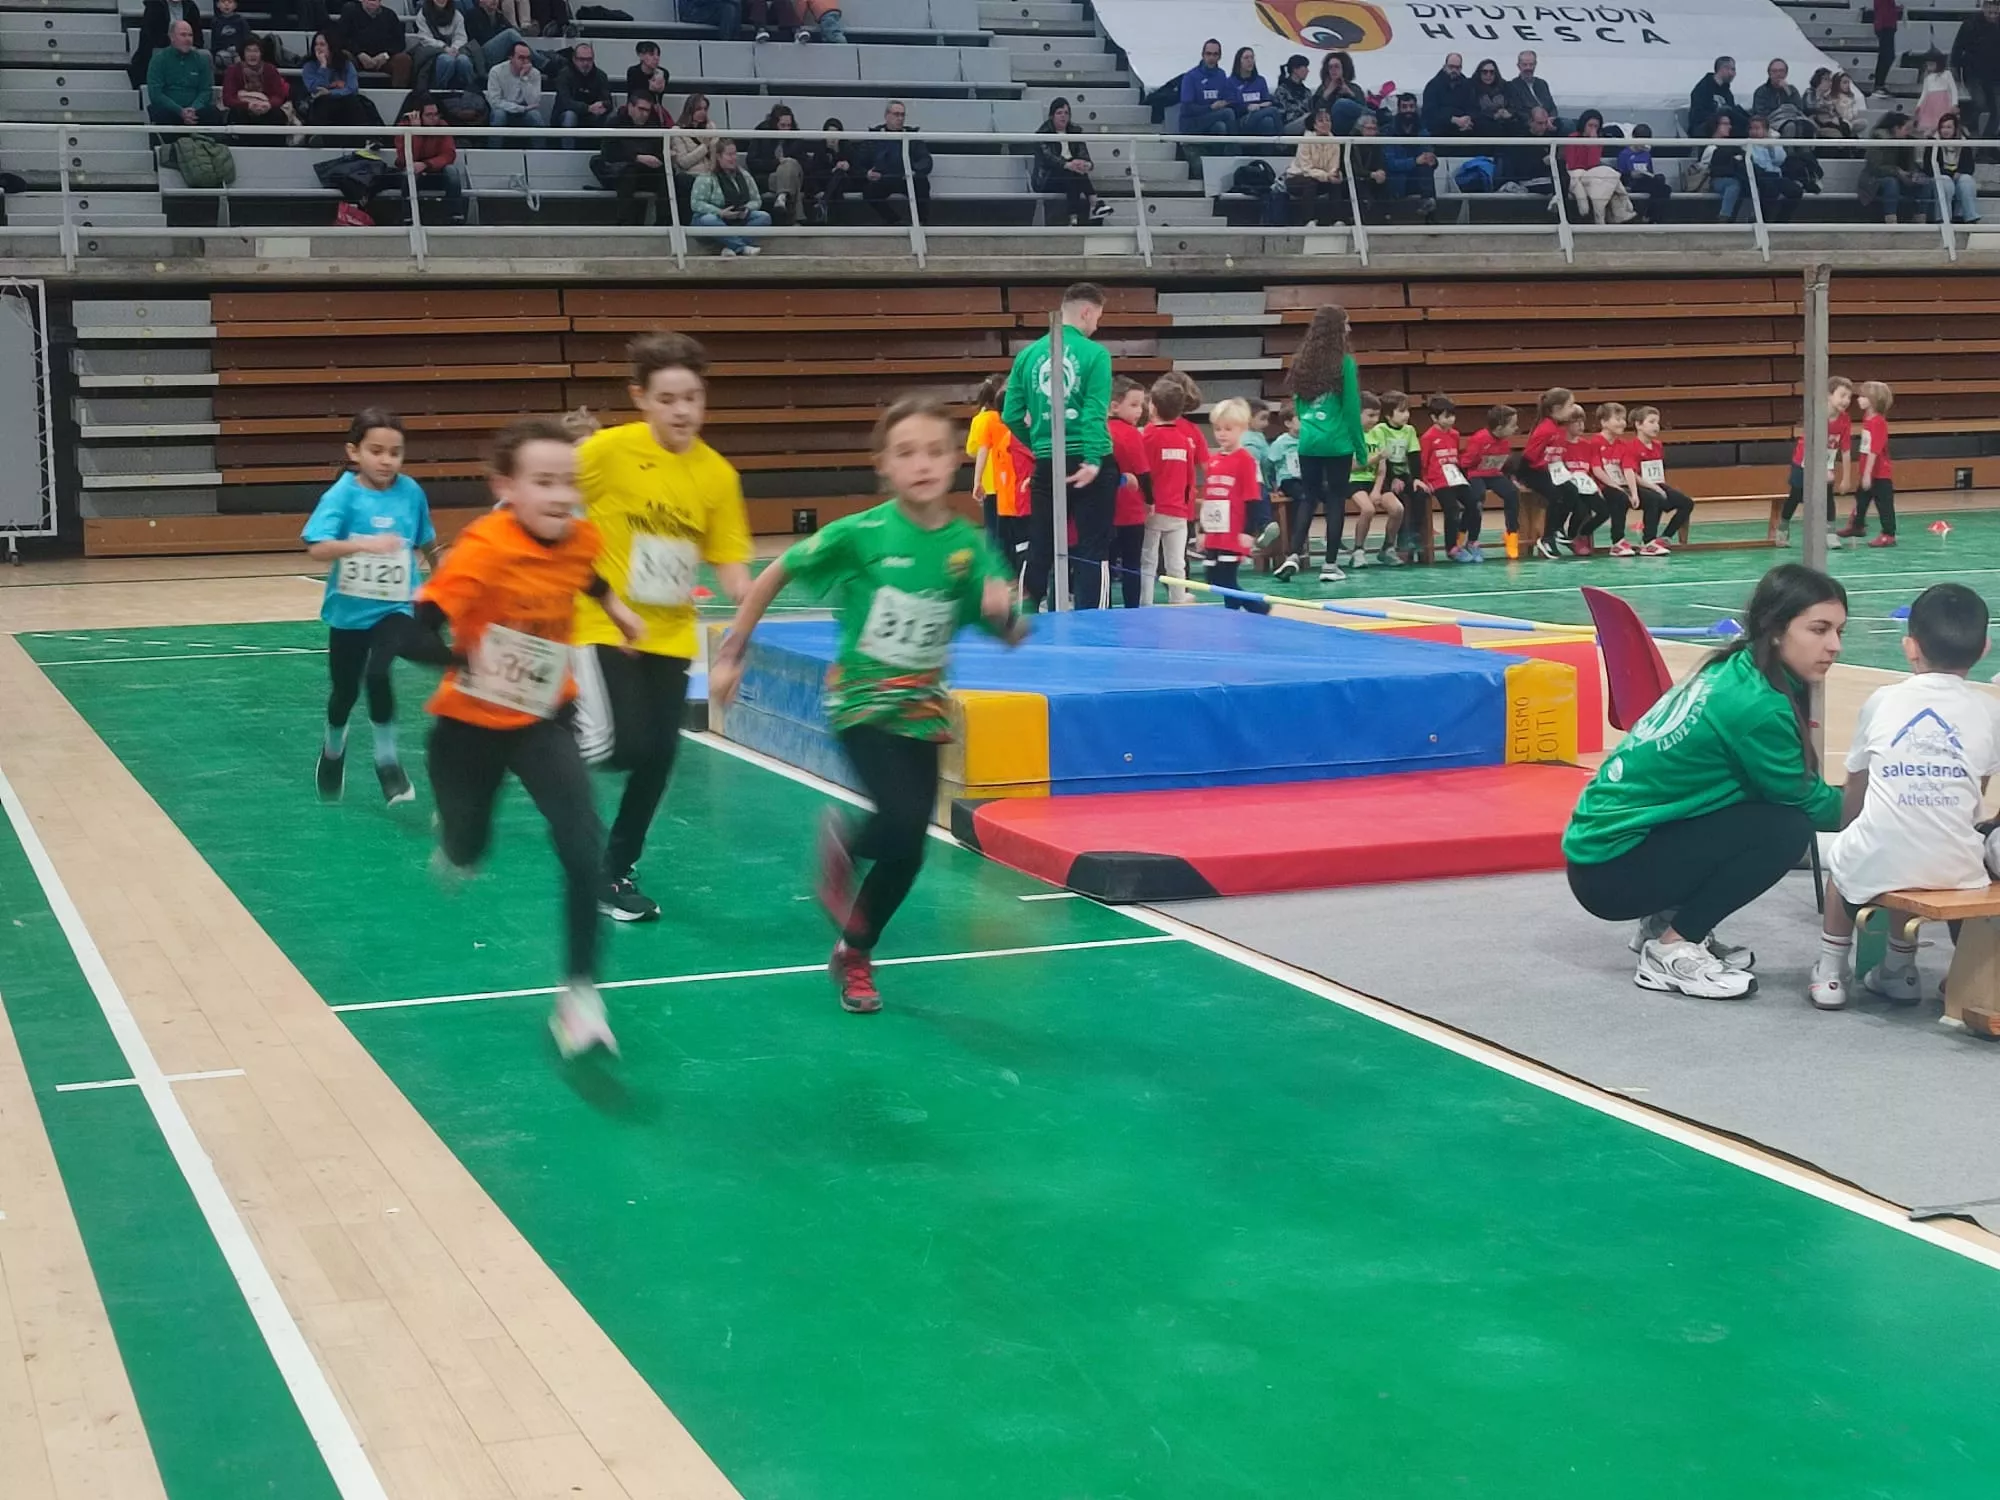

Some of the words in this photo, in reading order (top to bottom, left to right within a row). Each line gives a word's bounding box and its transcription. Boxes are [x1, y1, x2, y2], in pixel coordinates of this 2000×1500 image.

[1420, 22, 1671, 45] HUESCA
[343, 560, 405, 585] 3120
[1898, 793, 1960, 807] Atletismo
